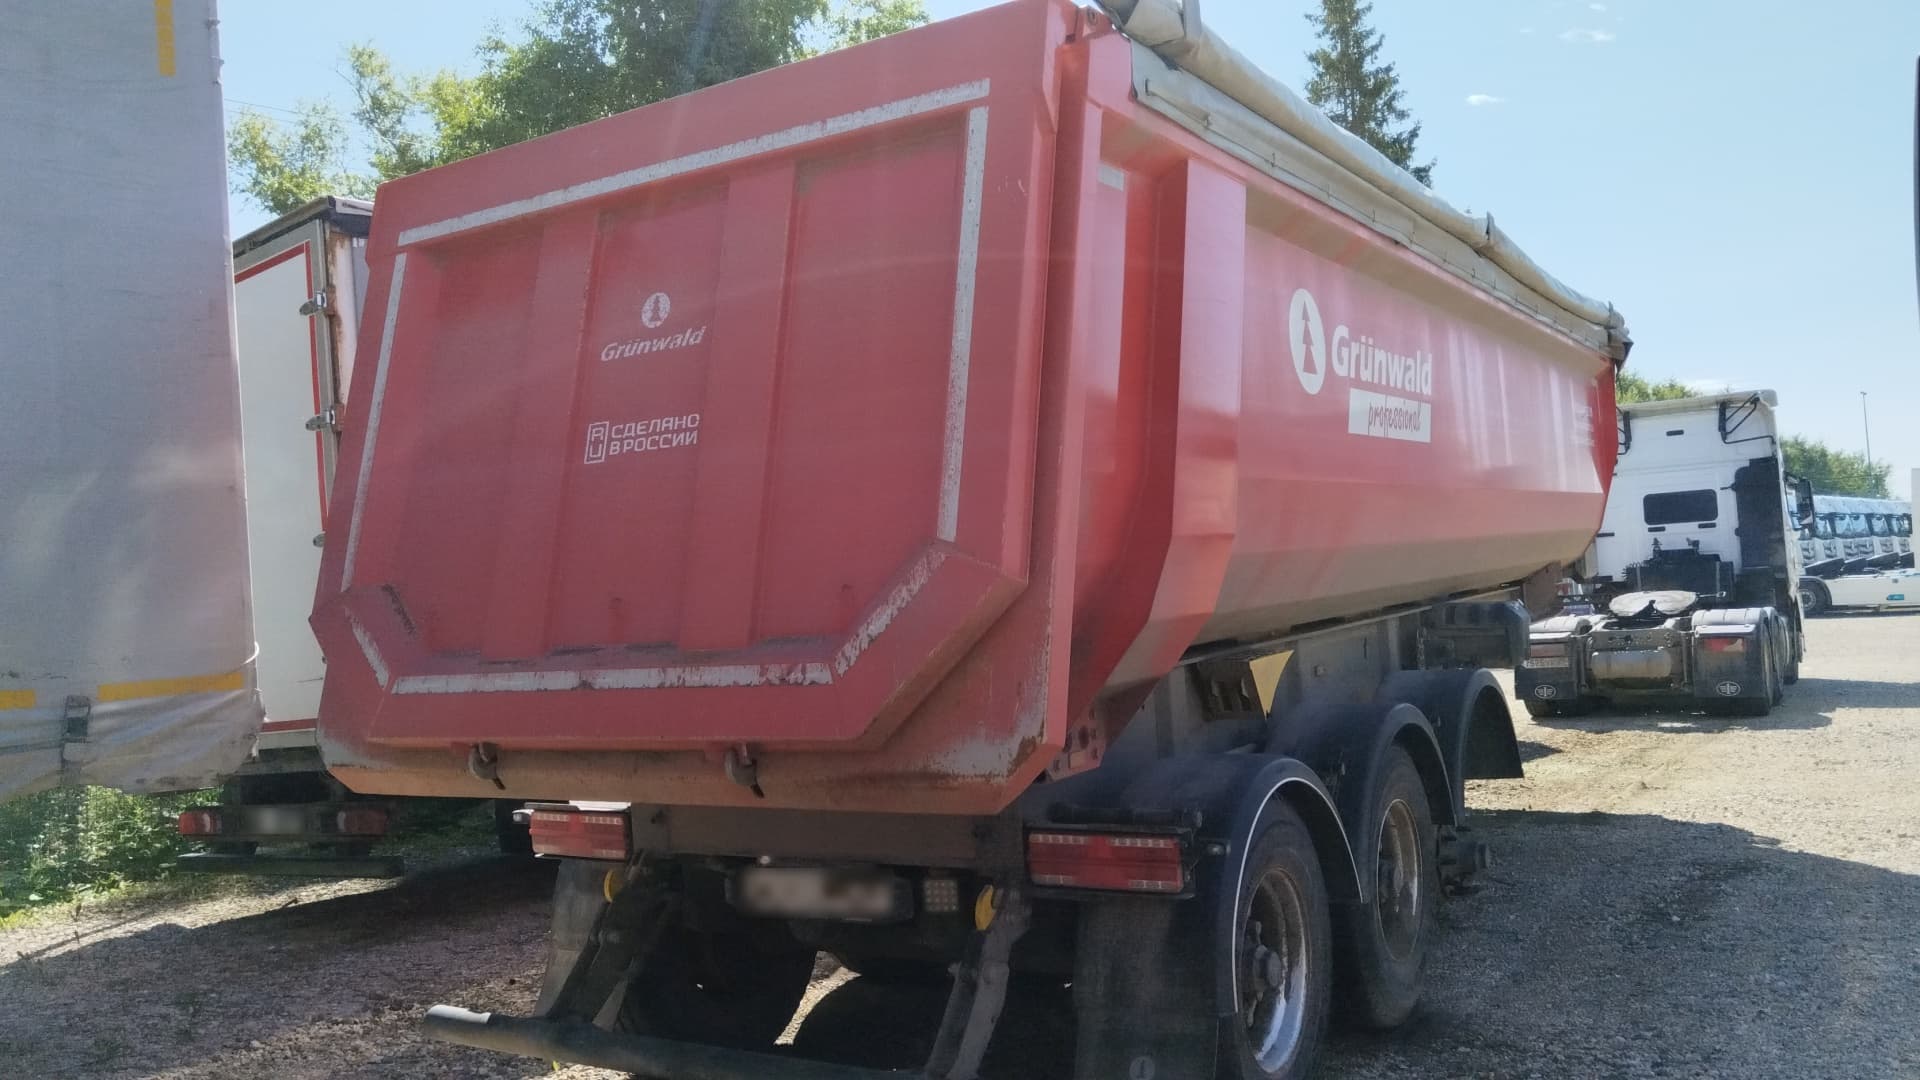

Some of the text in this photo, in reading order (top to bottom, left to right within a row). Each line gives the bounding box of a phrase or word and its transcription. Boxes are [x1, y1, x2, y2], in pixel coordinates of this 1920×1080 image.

[601, 325, 707, 362] Grünwald
[1331, 324, 1433, 396] Grünwald
[611, 414, 700, 439] СДЕЛАНО
[1367, 395, 1421, 438] professional
